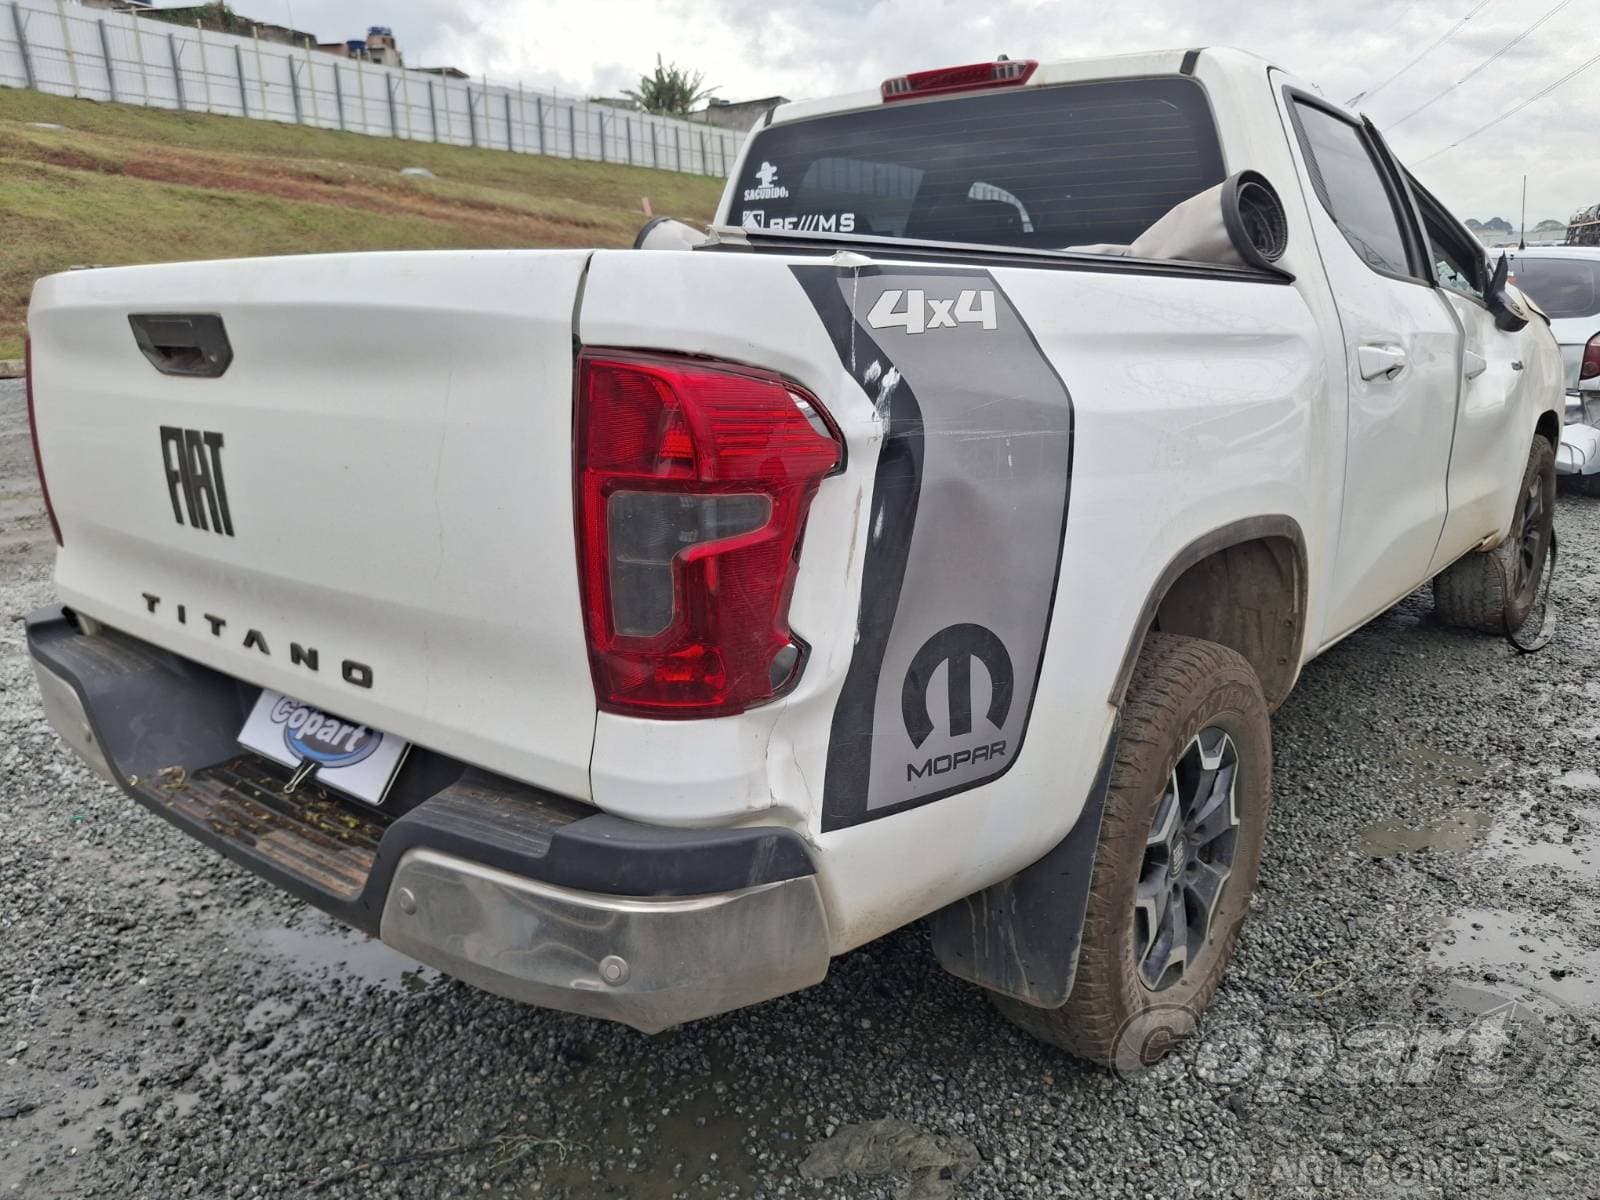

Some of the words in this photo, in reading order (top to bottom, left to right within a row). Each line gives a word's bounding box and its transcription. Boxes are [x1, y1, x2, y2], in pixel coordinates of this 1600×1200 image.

[866, 289, 997, 334] 4x4
[160, 425, 235, 537] FIAT
[142, 592, 373, 689] TITANO
[270, 696, 367, 752] Copart
[906, 740, 1007, 781] MOPAR
